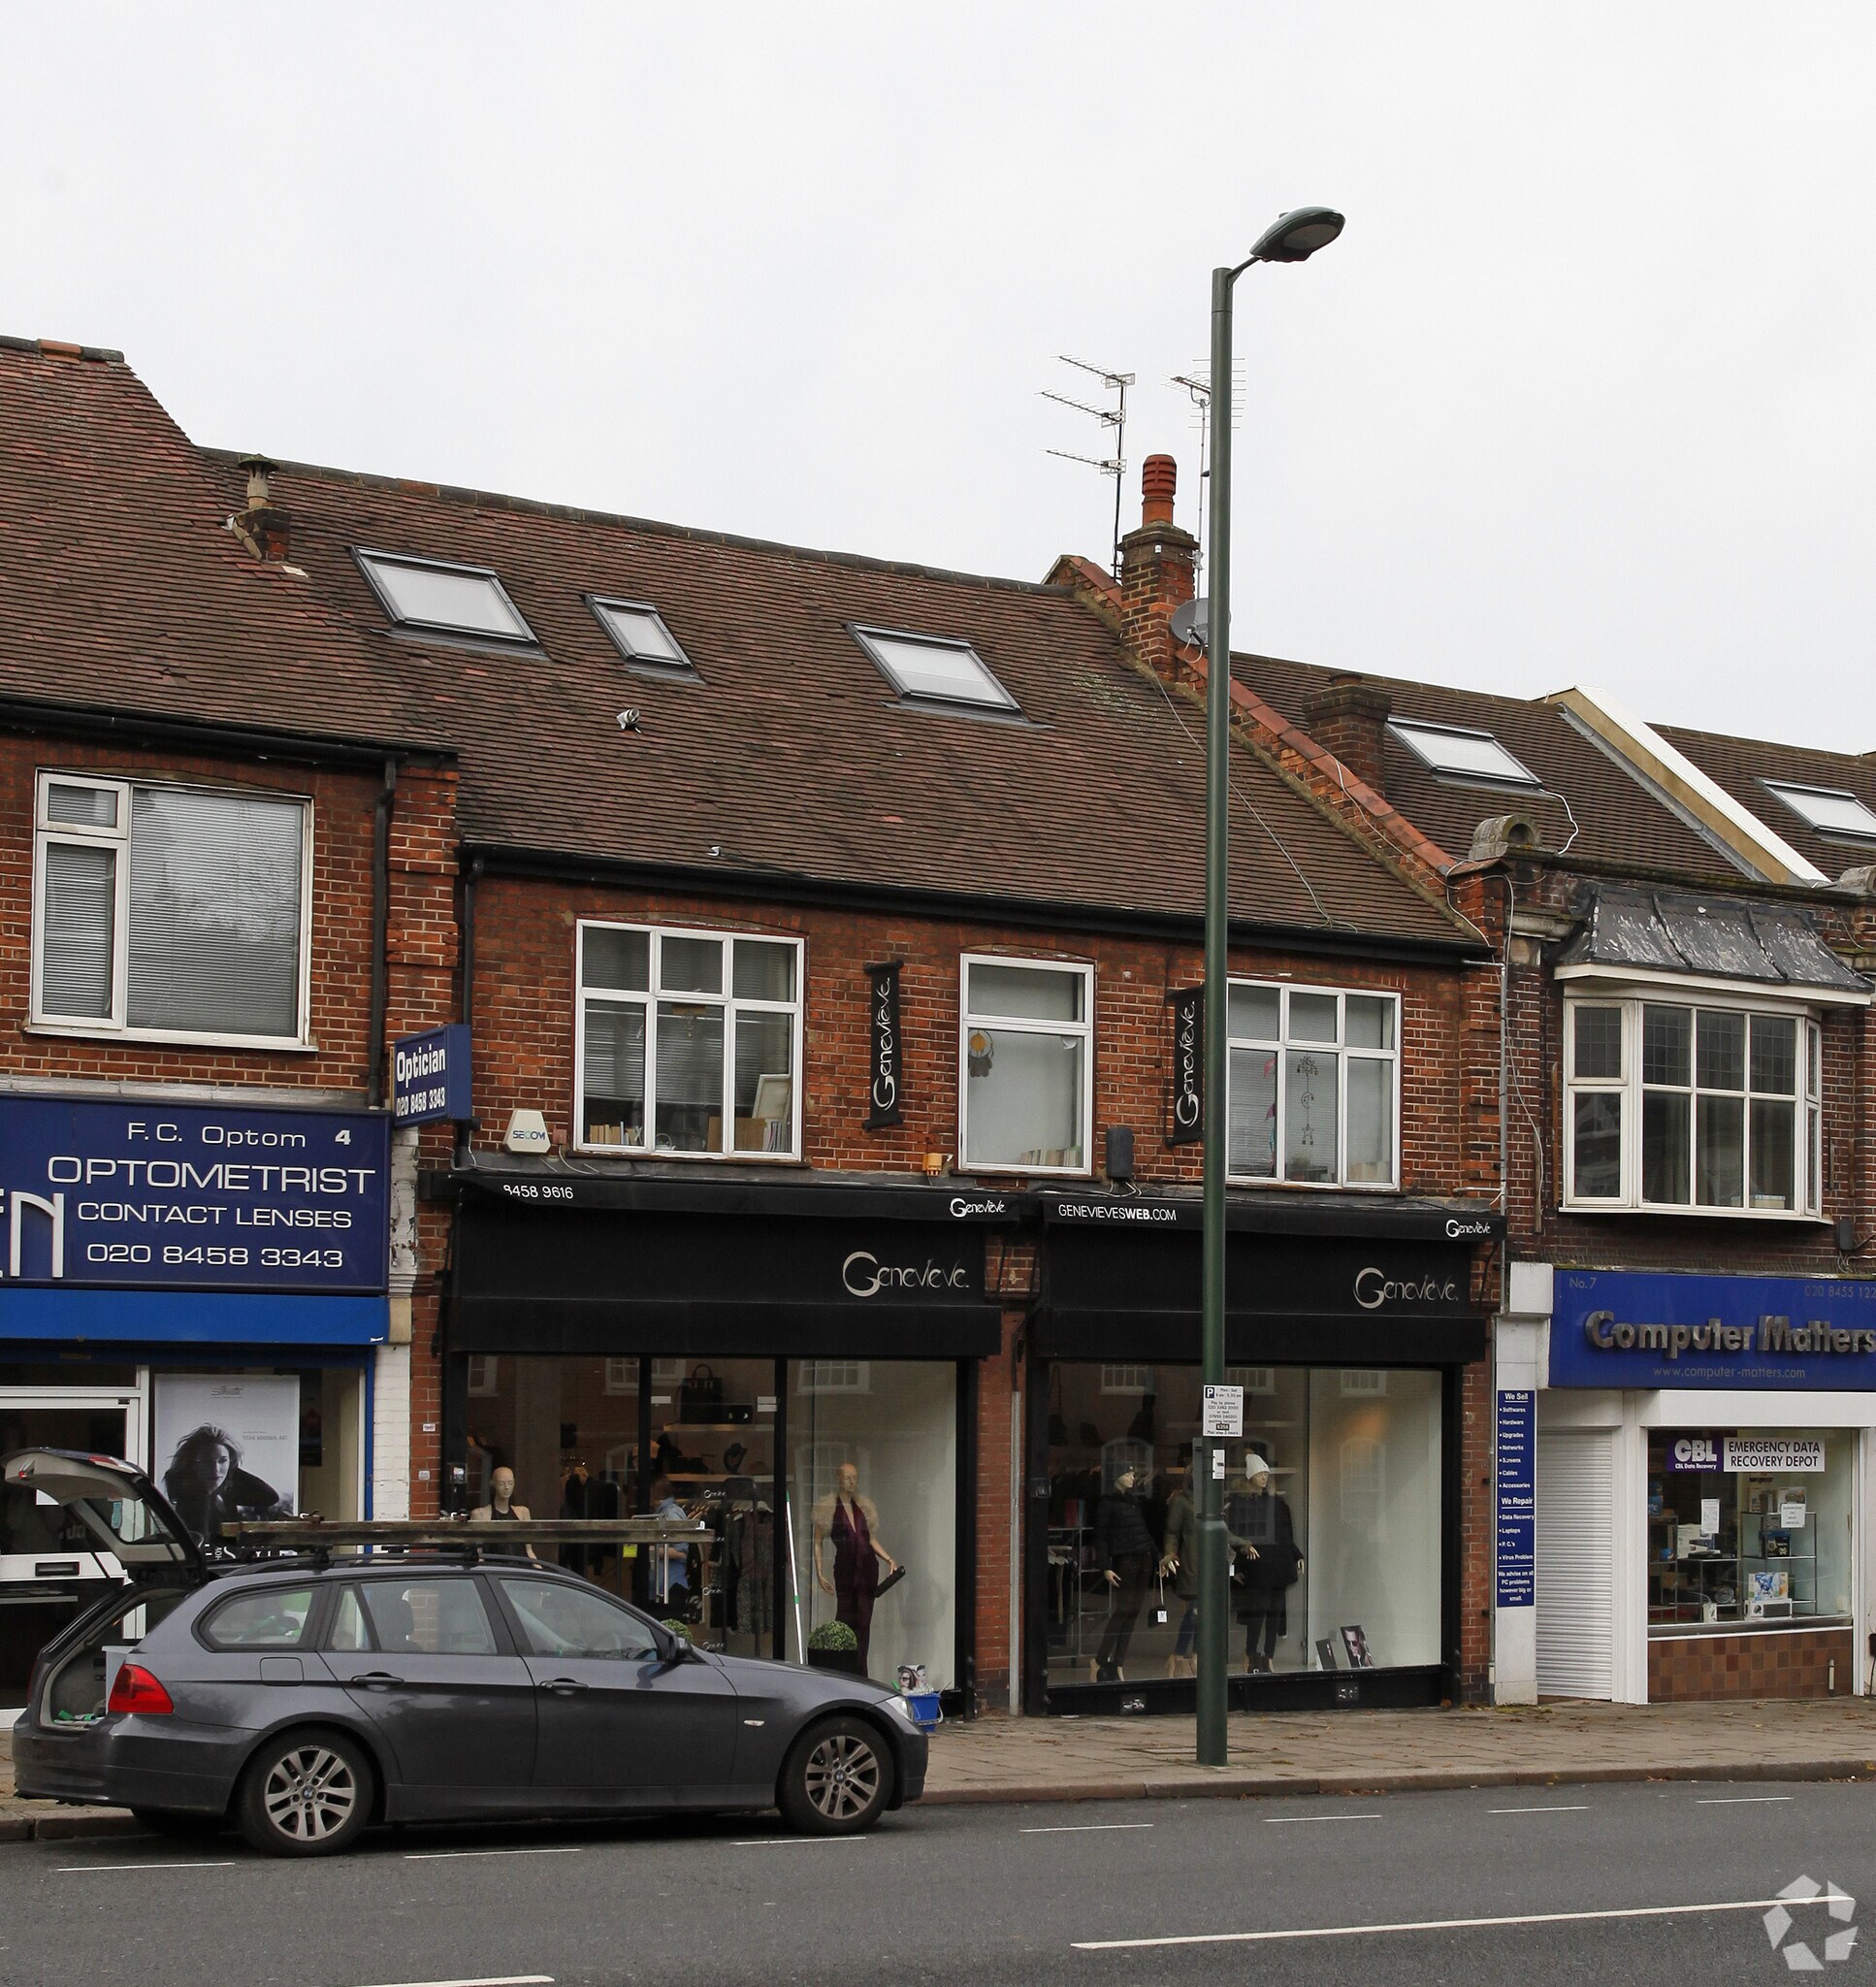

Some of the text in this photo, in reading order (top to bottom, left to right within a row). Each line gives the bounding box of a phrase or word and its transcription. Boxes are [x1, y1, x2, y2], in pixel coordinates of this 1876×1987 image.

[397, 1043, 446, 1089] Optician
[396, 1087, 446, 1117] 020 8458 3343
[201, 1124, 307, 1148] Optom
[335, 1129, 352, 1146] 4
[512, 1130, 546, 1140] SECOM
[47, 1156, 376, 1195] OPTOMETRIST
[542, 1186, 574, 1199] 9616
[77, 1202, 353, 1229] CONTACT LENSES
[1058, 1204, 1177, 1222] GENEVIEVESWEB.COM
[86, 1243, 344, 1268] 020 8458 3343
[1827, 1286, 1854, 1298] 8455
[1584, 1311, 1876, 1358] Computer Matters
[1674, 1439, 1718, 1462] CBL
[1729, 1441, 1821, 1453] EMERGENCY DATA
[1730, 1455, 1819, 1467] RECOVERY DEPOT
[1513, 1497, 1533, 1506] Repair
